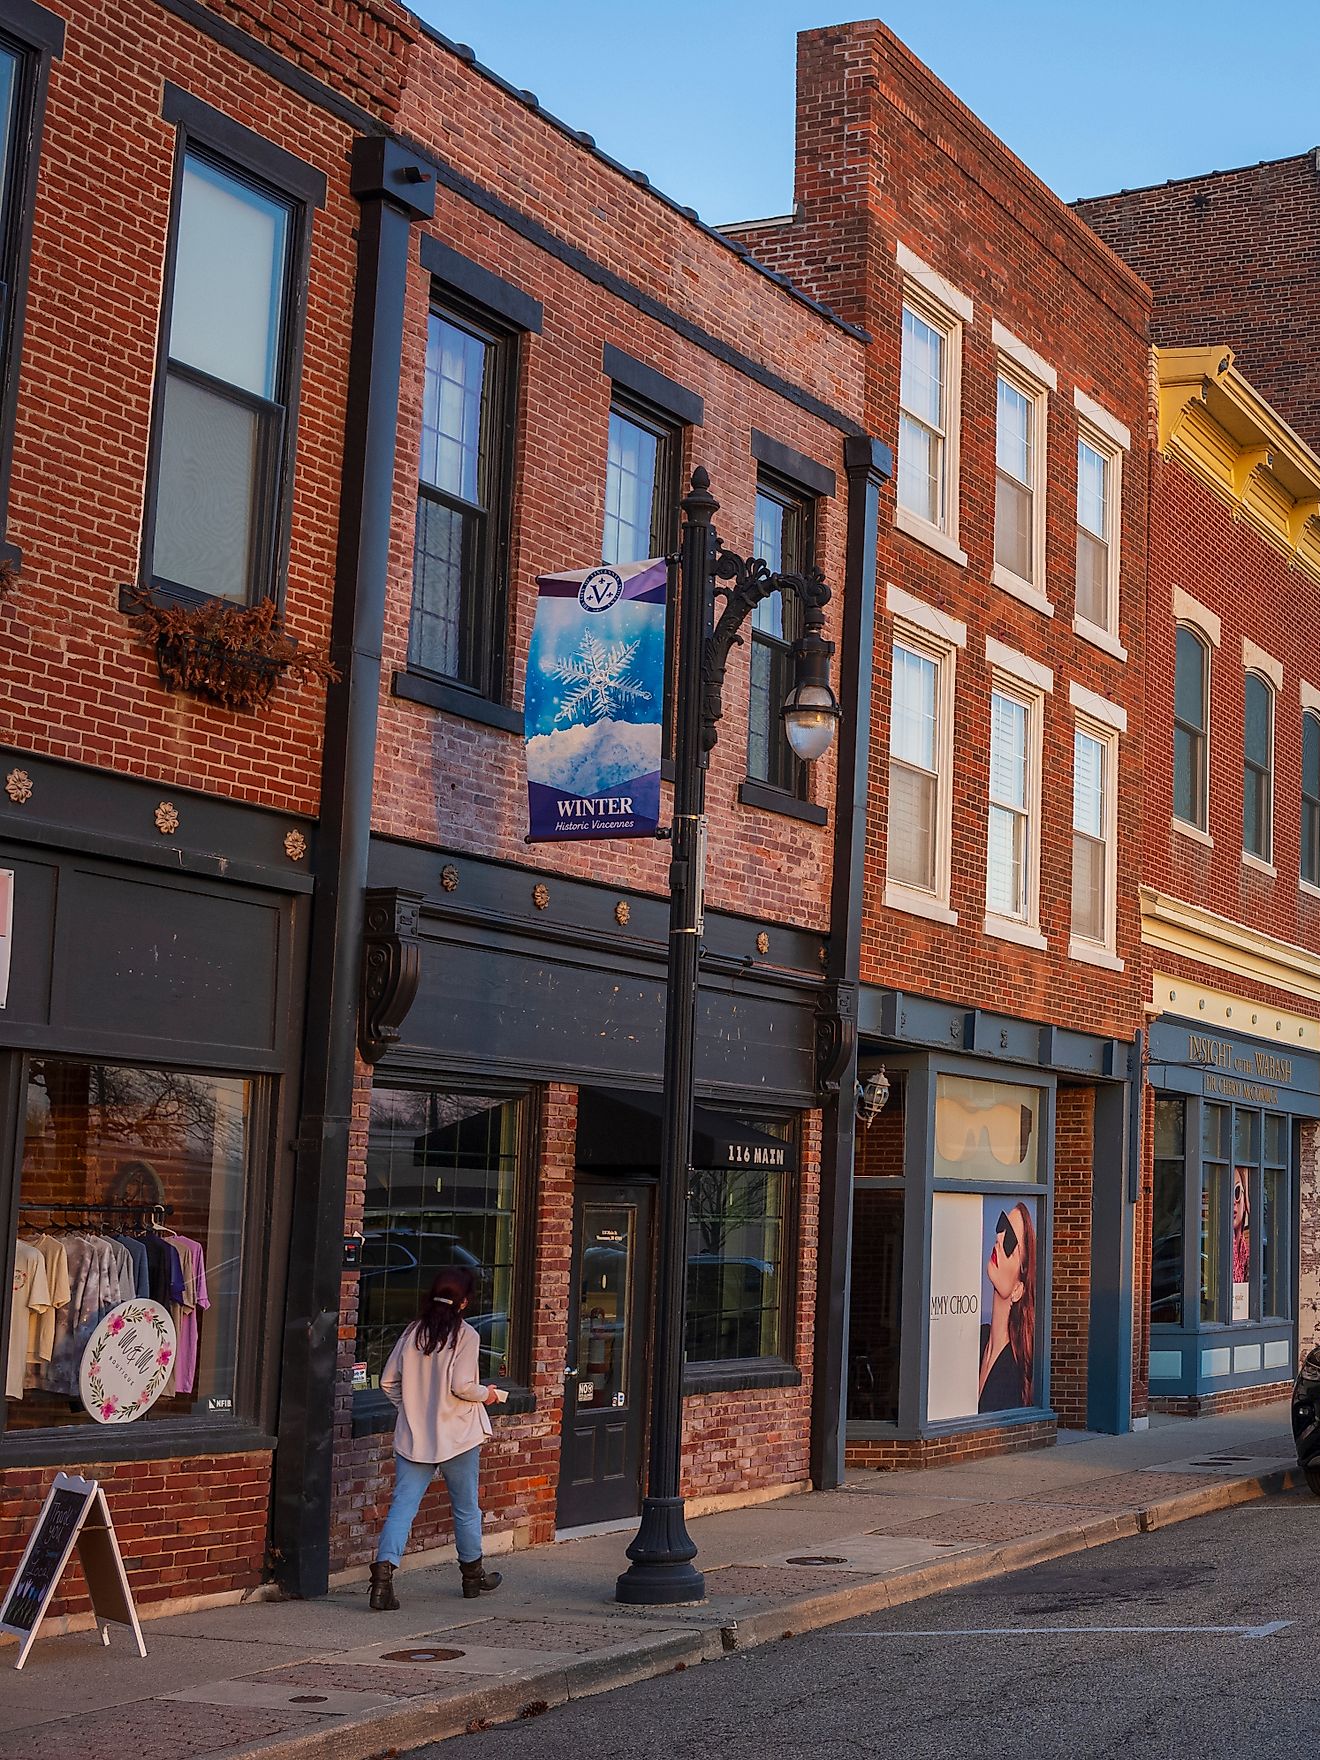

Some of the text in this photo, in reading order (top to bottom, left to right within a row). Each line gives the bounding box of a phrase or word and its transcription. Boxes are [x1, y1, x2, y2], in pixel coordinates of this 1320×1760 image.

[557, 797, 634, 818] WINTER
[555, 819, 634, 831] Historic Vincennes
[1188, 1035, 1233, 1070] INSIGHT
[1255, 1052, 1292, 1082] WABASH
[728, 1145, 784, 1165] 116 MAIN
[950, 1294, 978, 1315] CHOO
[109, 1355, 134, 1386] BOUTIQUE
